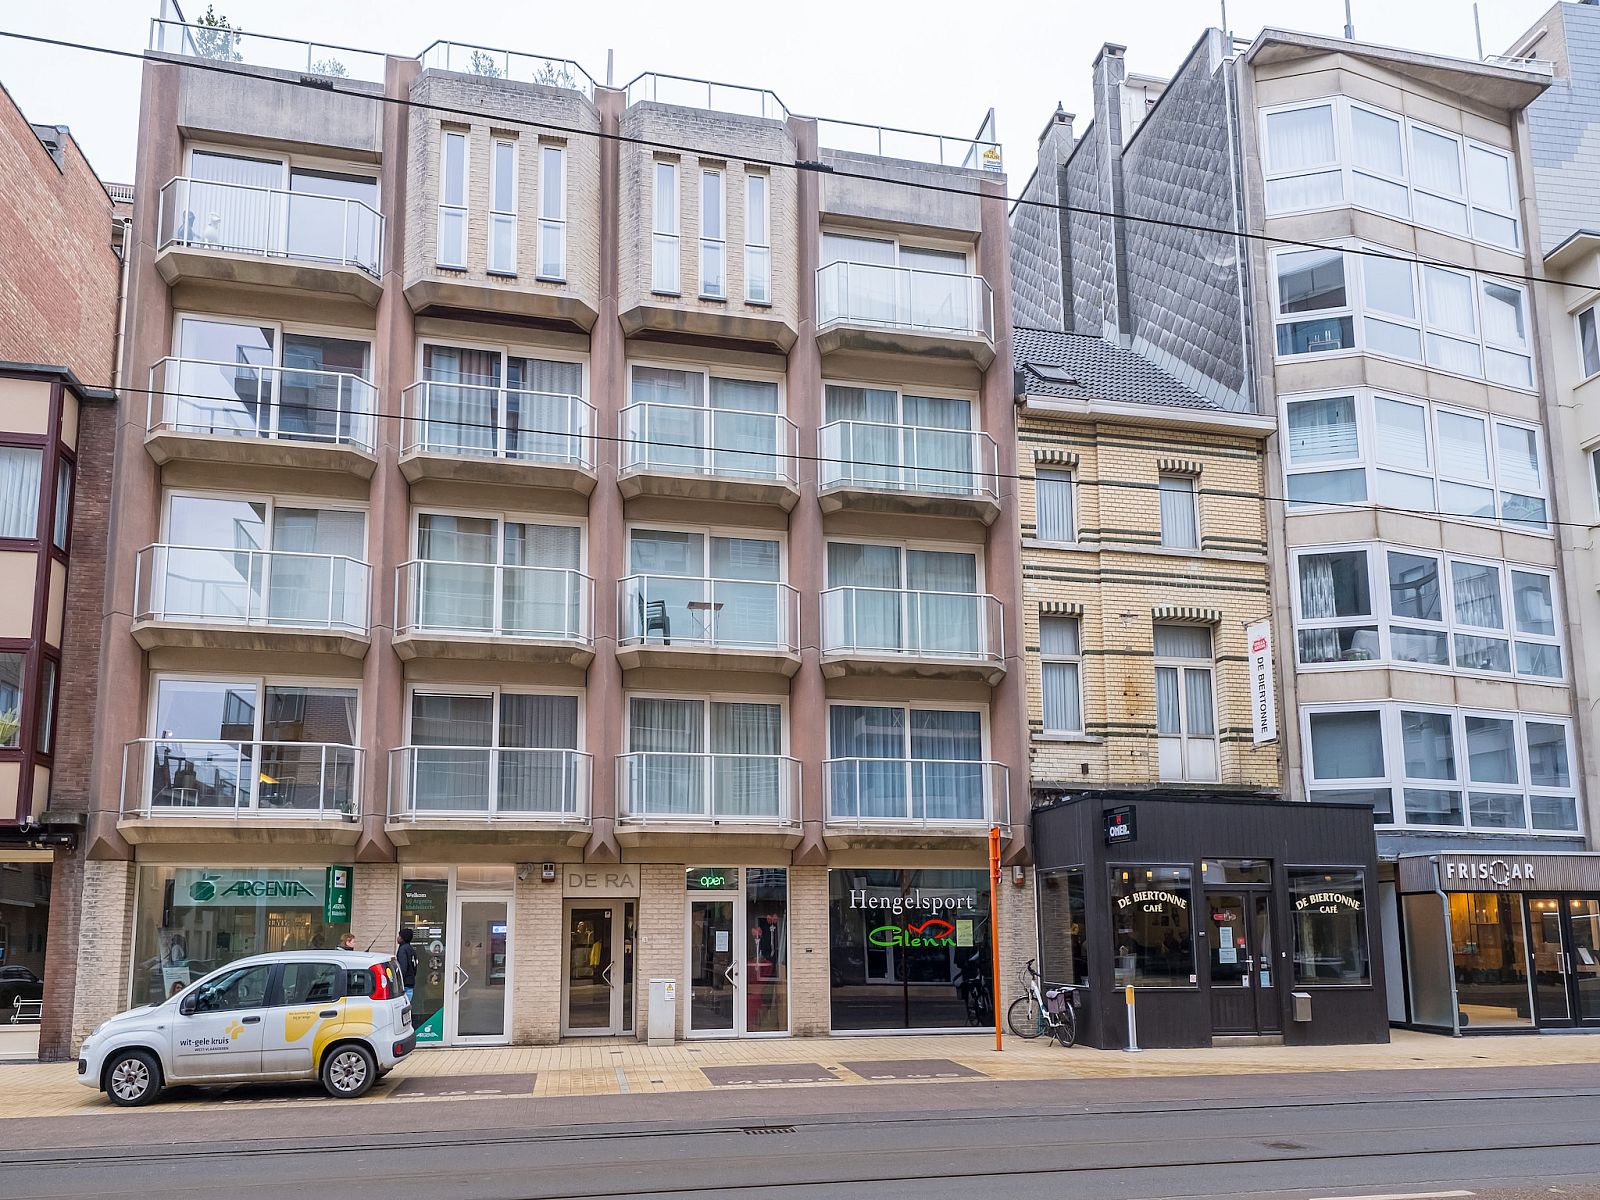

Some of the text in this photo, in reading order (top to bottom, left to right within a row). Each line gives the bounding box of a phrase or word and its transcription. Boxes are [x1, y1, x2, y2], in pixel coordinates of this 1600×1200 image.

[1257, 656, 1265, 671] DE
[1258, 673, 1268, 733] BIERTONNE
[568, 873, 634, 888] DE RA
[1446, 859, 1535, 887] FRISQAR
[220, 880, 316, 897] ARGENTA
[700, 876, 725, 888] open
[849, 888, 974, 915] Hengelsport
[1117, 890, 1187, 910] DE BIERTONNE
[1143, 903, 1163, 913] CAFÉ
[1295, 892, 1361, 911] DE BIERTONNE
[1319, 904, 1339, 914] CAFÉ
[868, 925, 956, 947] Glenn
[179, 1036, 229, 1048] wit-gele kruis
